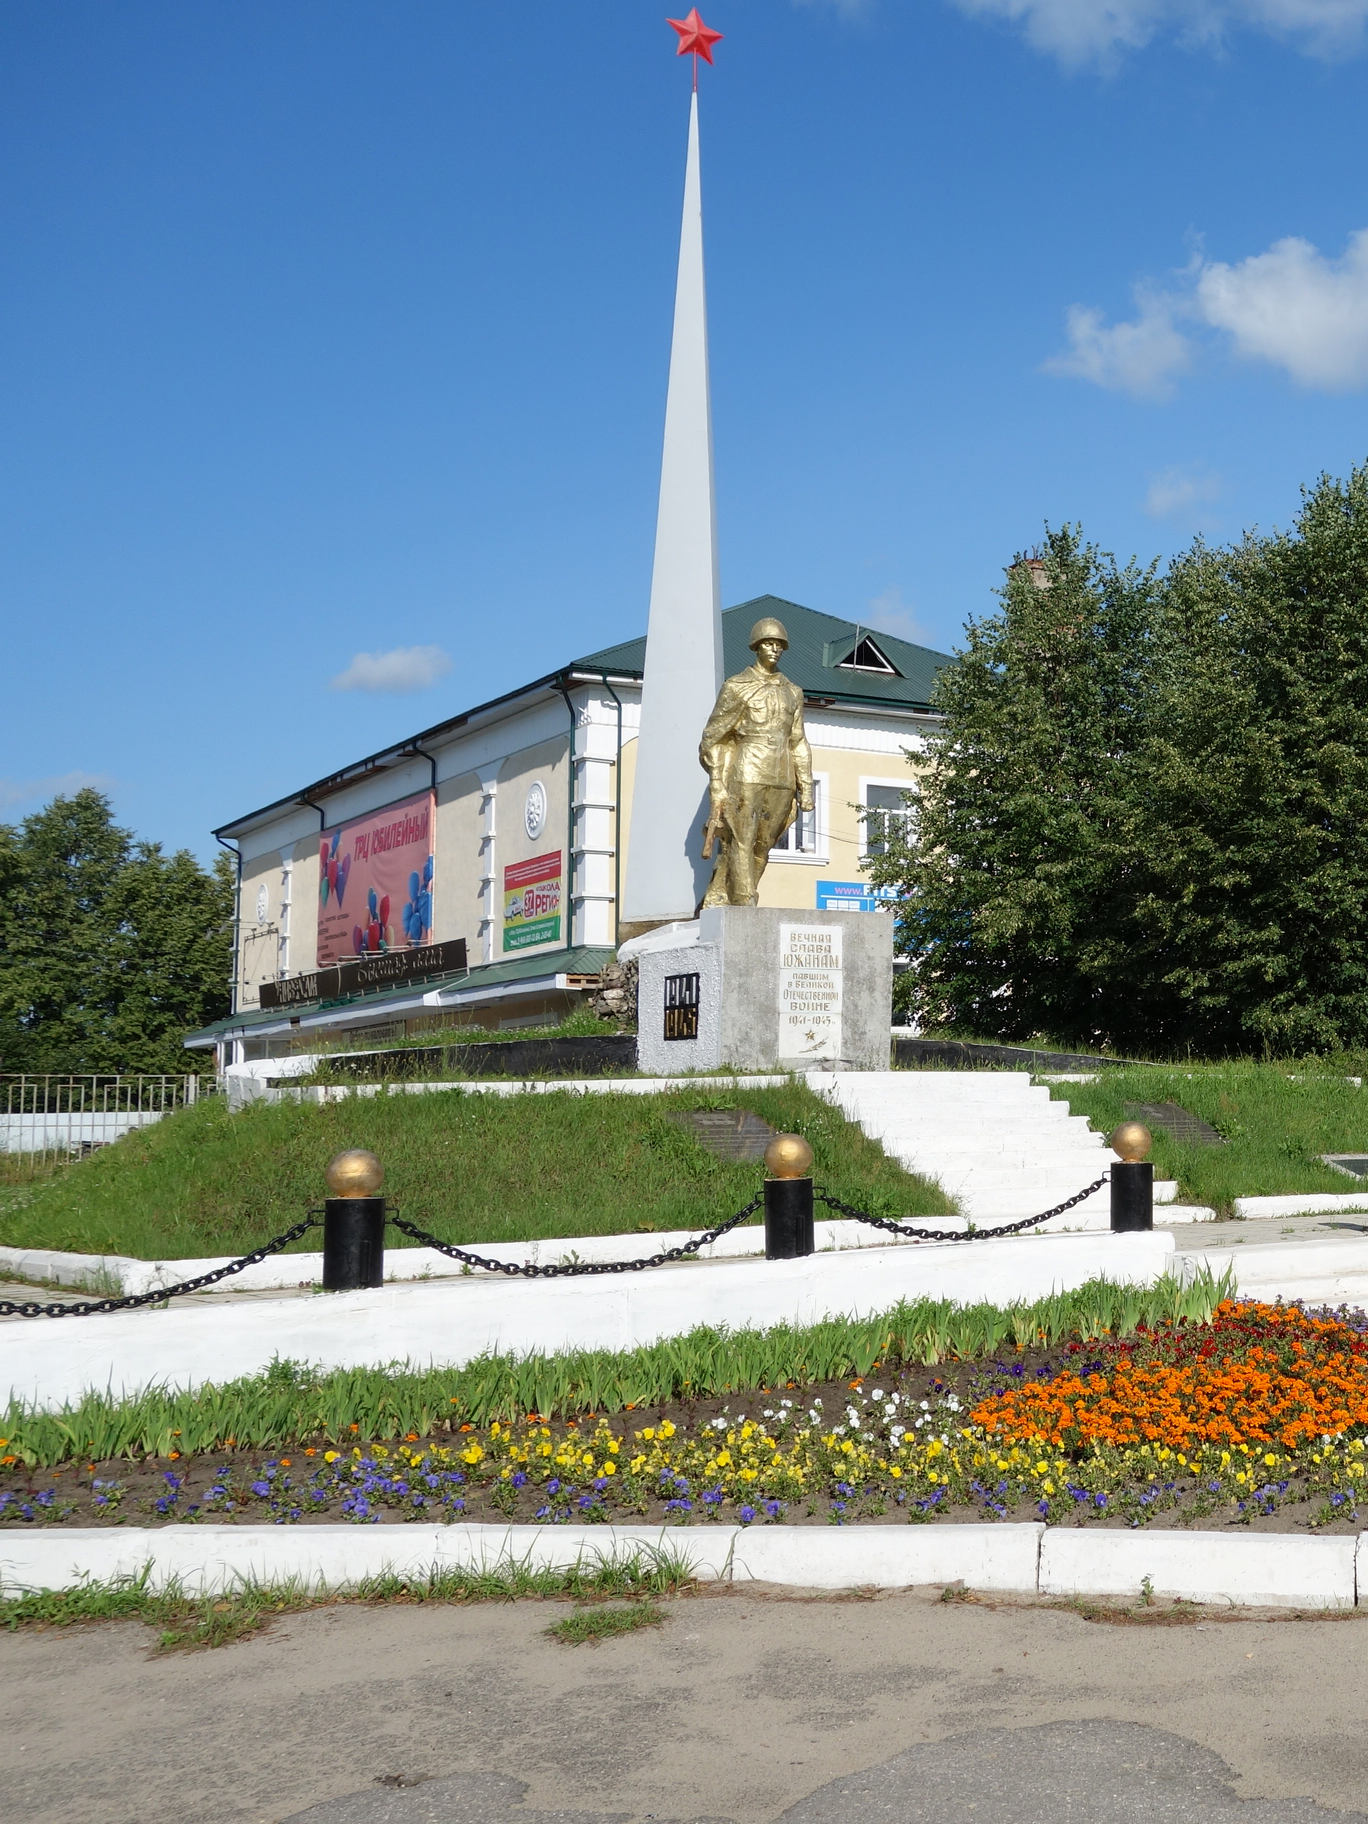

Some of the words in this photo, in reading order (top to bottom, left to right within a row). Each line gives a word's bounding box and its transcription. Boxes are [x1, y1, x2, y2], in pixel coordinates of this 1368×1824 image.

[354, 834, 370, 863] ТРЦ
[370, 807, 429, 856] ЮБИЛЕЙНЫЙ
[790, 933, 832, 943] ВЕЧНАЯ
[790, 944, 831, 954] СЛАВА
[783, 953, 839, 968] ЮЖАНАМ
[666, 976, 697, 1006] 1941
[666, 1007, 697, 1037] 1945
